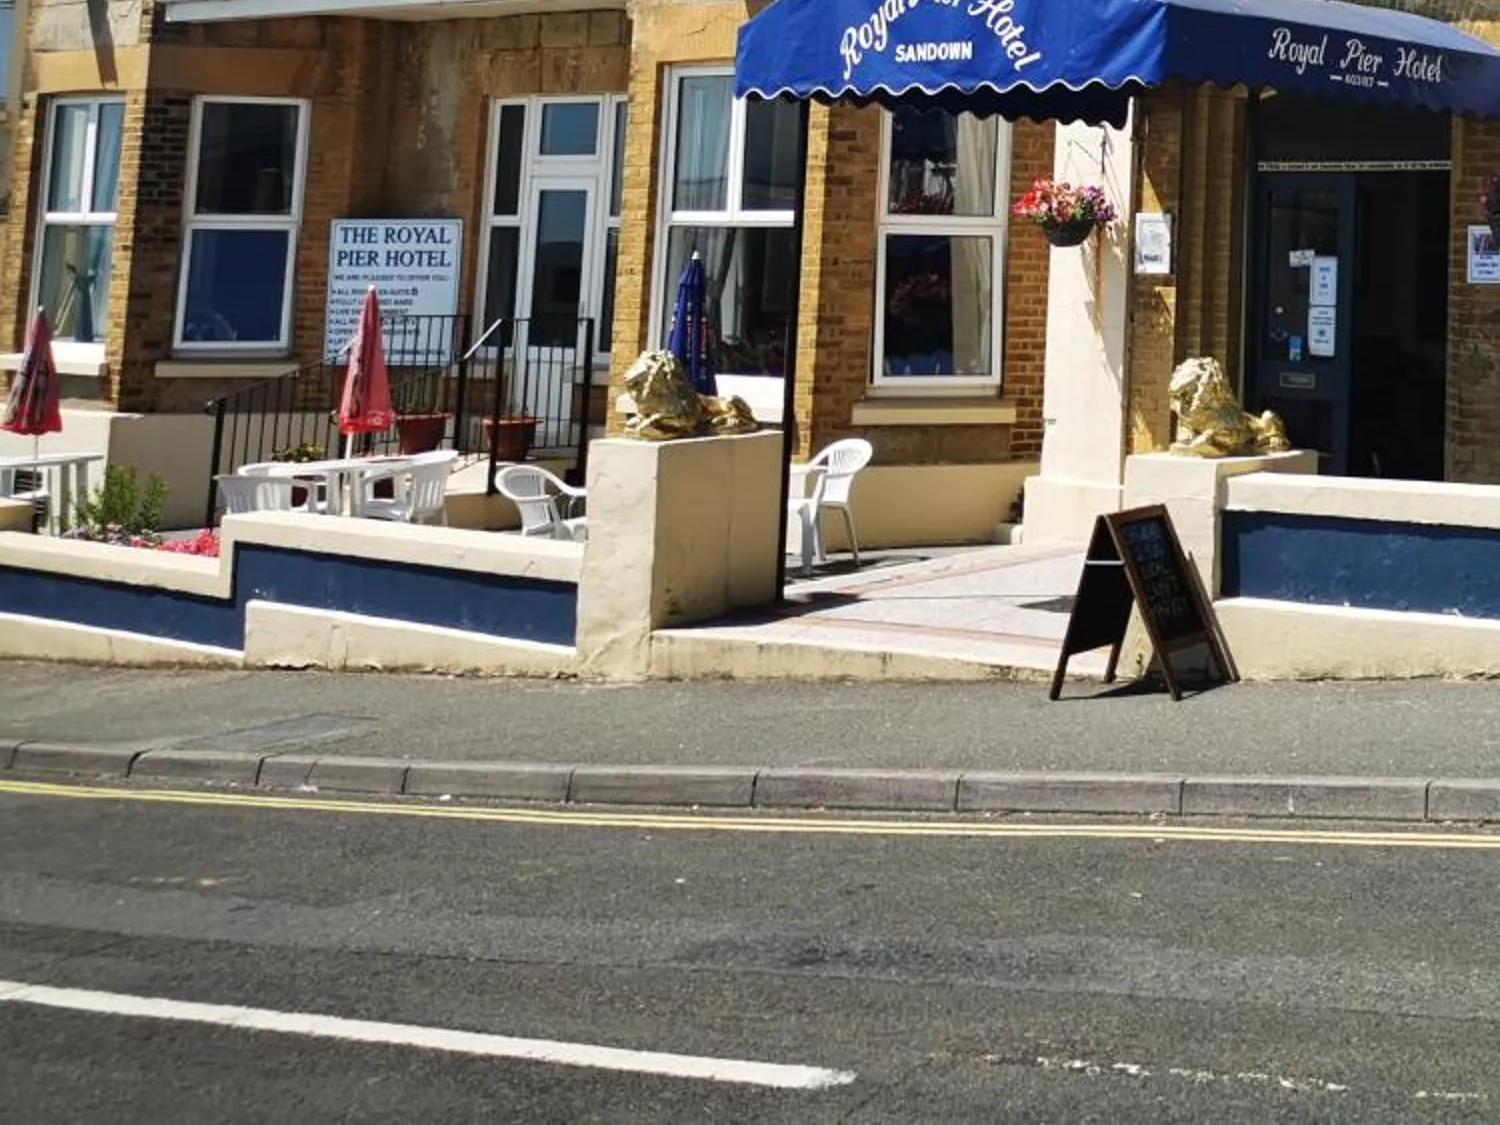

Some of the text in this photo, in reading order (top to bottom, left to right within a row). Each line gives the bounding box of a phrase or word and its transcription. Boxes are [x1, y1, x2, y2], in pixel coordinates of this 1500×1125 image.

[894, 40, 973, 63] SANDOWN
[1267, 26, 1443, 84] Royal Pier Hotel
[340, 226, 452, 244] THE ROYAL
[336, 250, 452, 268] PIER HOTEL
